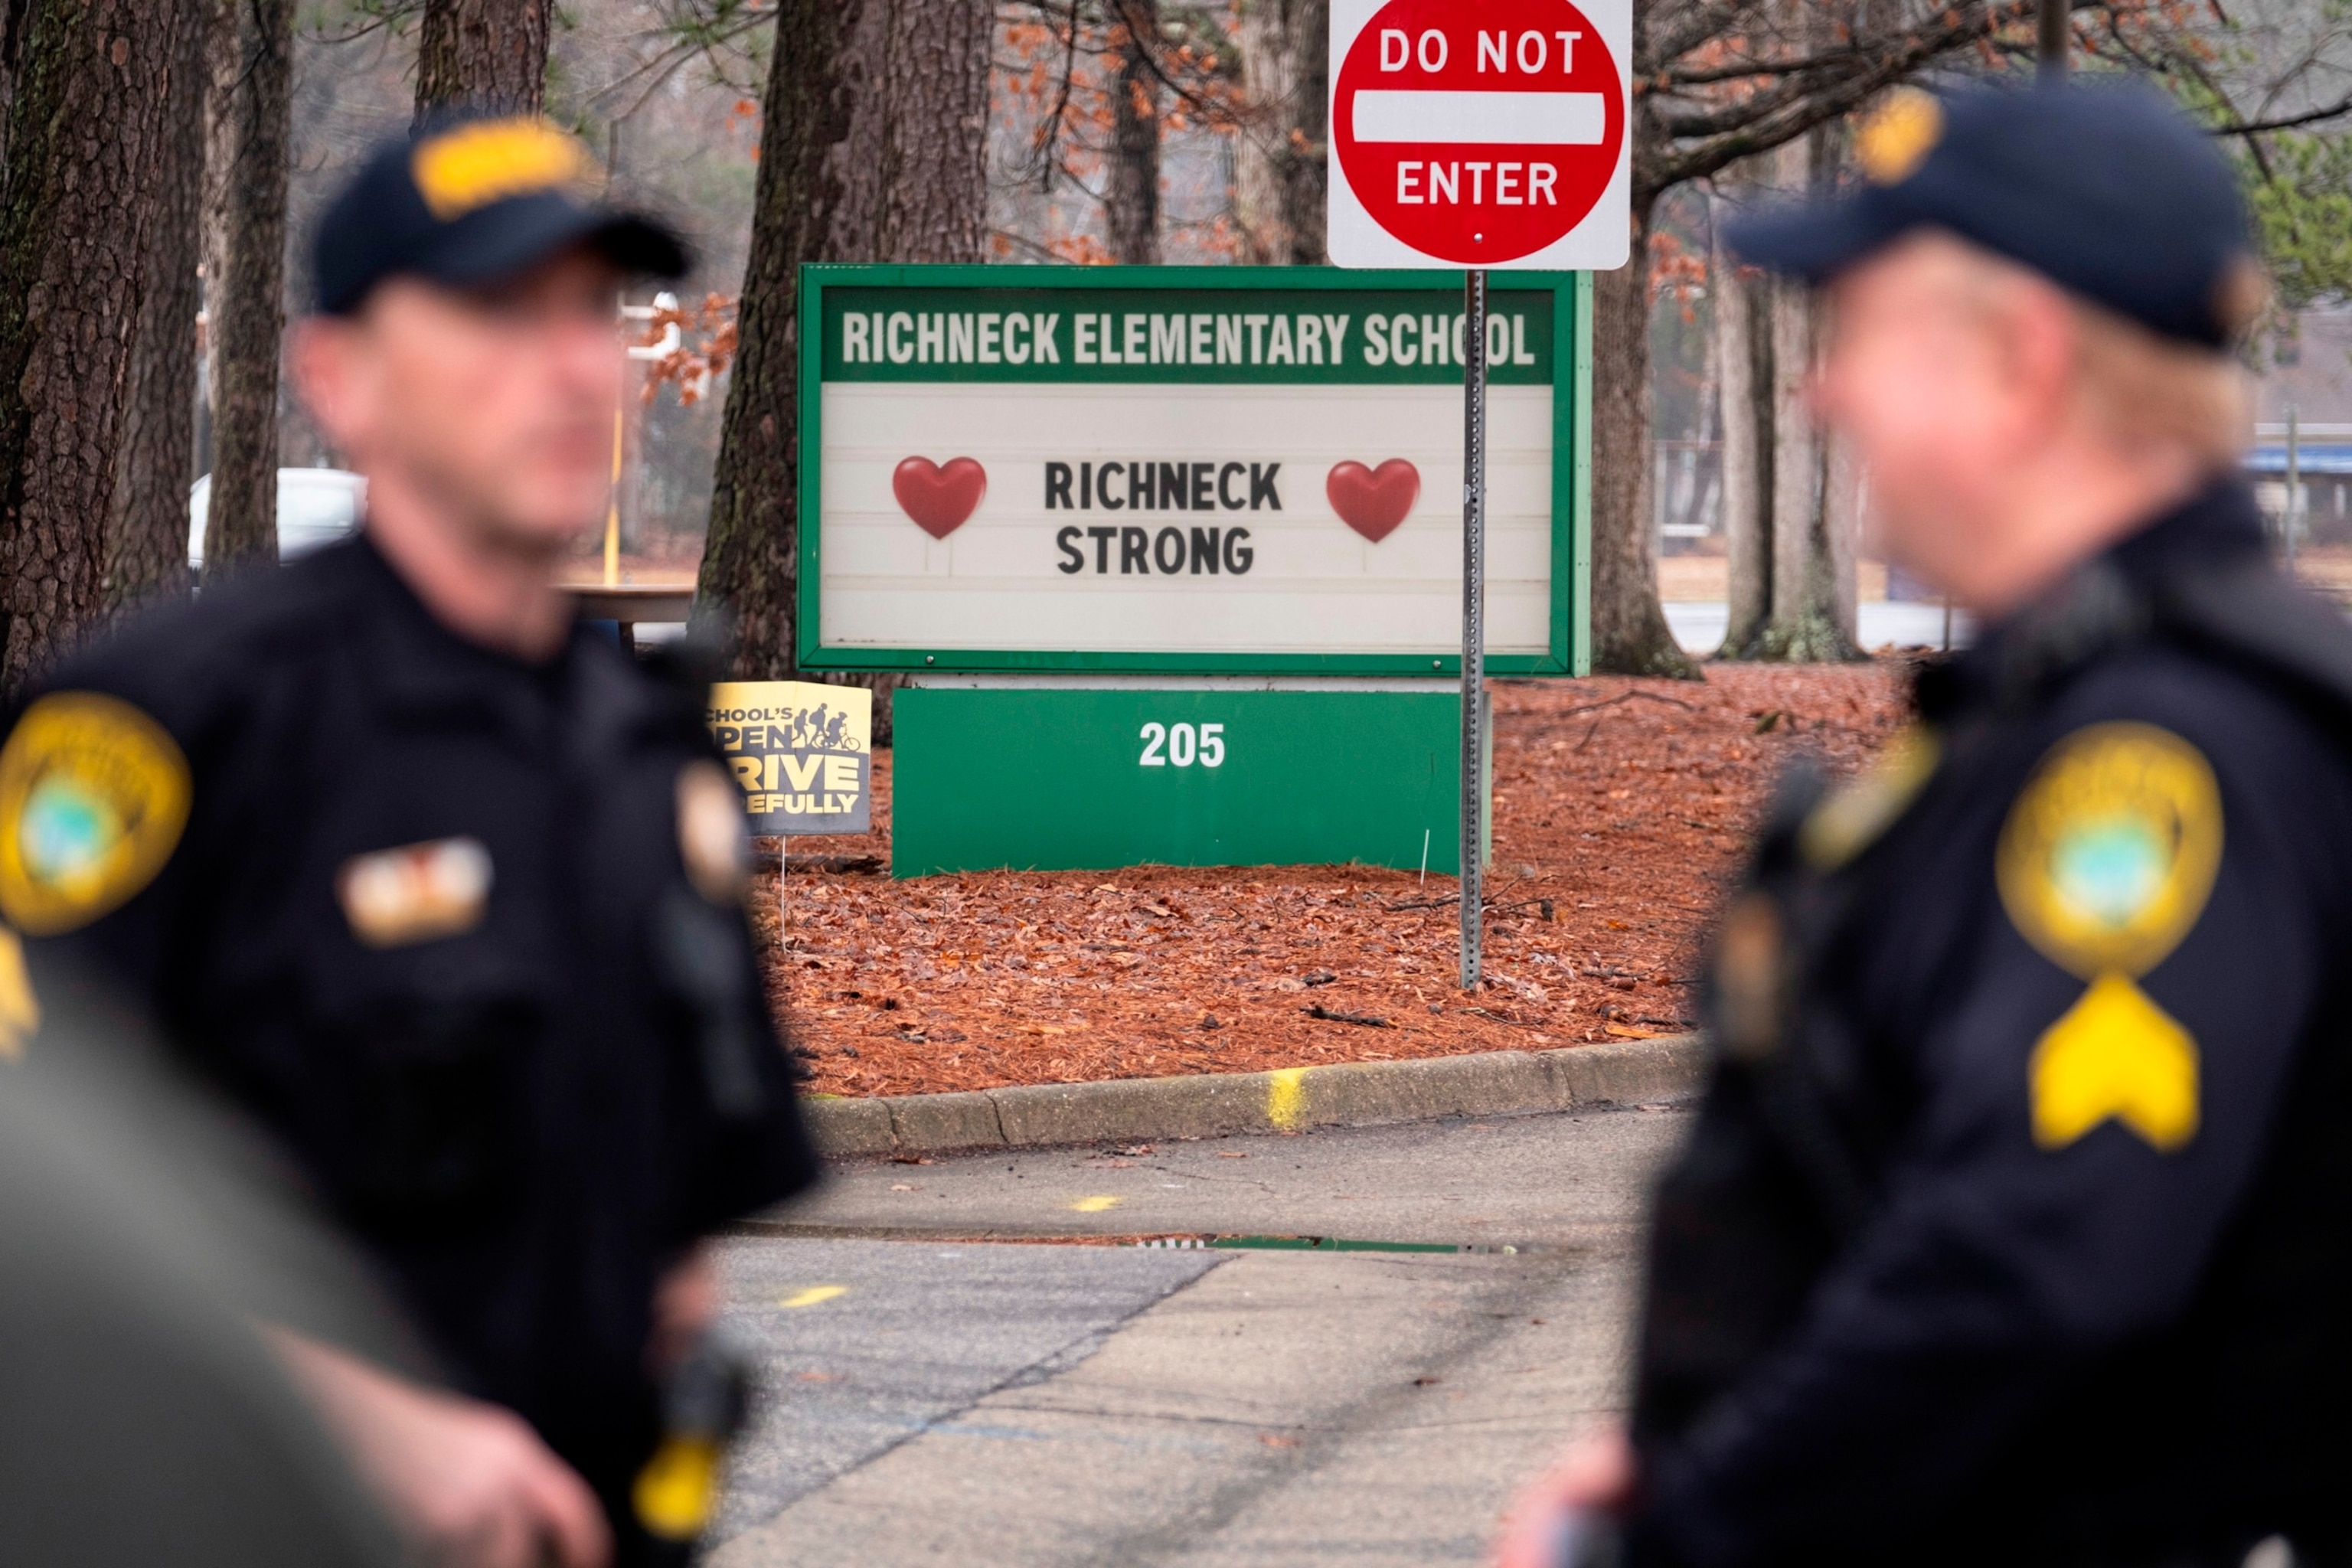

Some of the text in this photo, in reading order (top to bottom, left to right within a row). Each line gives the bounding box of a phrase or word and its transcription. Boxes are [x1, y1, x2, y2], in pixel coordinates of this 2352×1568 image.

[1380, 29, 1582, 74] DO NOT
[1397, 161, 1557, 205] ENTER
[843, 312, 1535, 366] RICHNECK ELEMENTARY SCHOOL
[1045, 461, 1282, 511] RICHNECK
[1057, 526, 1253, 575] STRONG
[708, 724, 793, 751] PEN
[1139, 721, 1225, 768] 205
